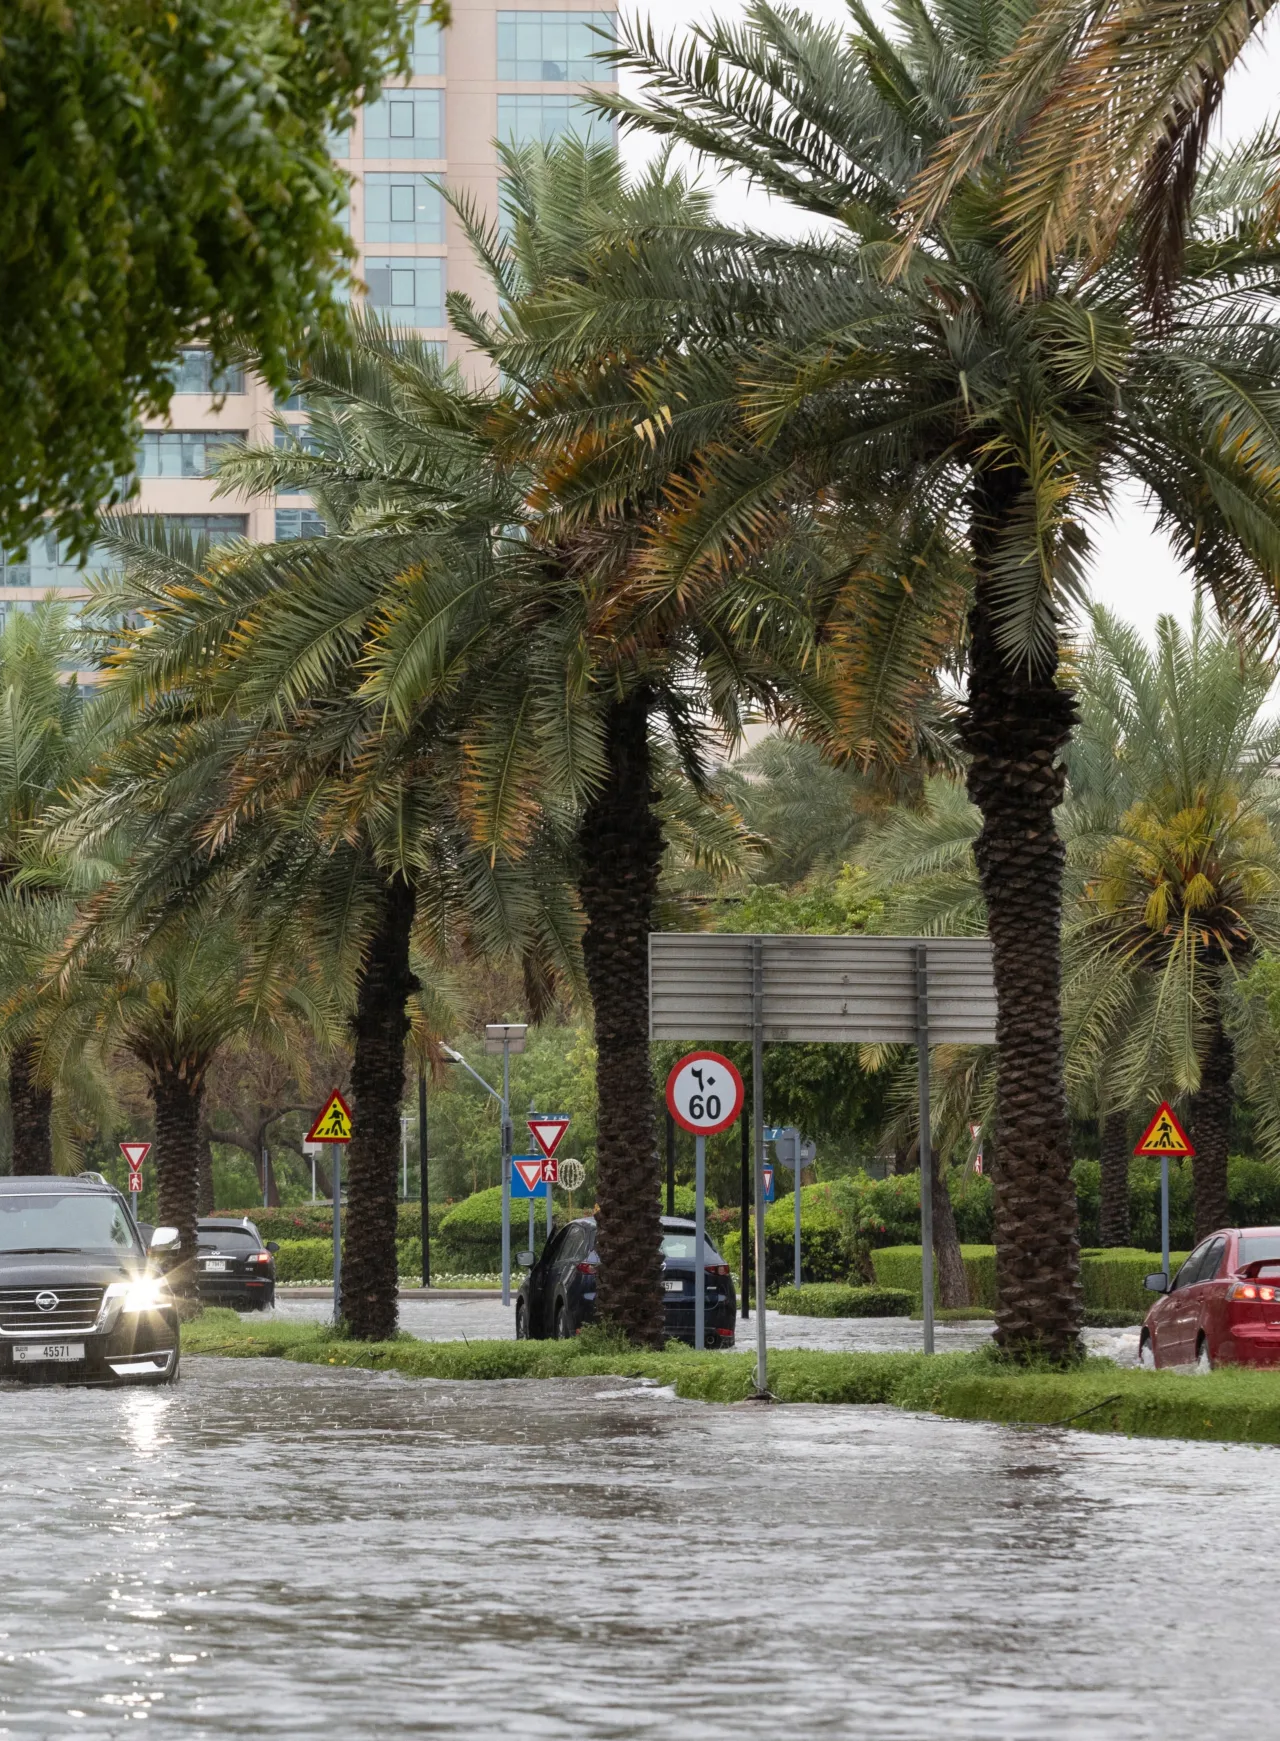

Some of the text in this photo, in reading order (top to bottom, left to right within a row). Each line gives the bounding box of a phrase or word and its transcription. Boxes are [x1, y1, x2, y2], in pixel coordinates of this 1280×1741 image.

[691, 1067, 716, 1093] ٦٠
[689, 1094, 721, 1120] 60
[771, 1129, 778, 1139] 7
[43, 1345, 70, 1358] 45571
